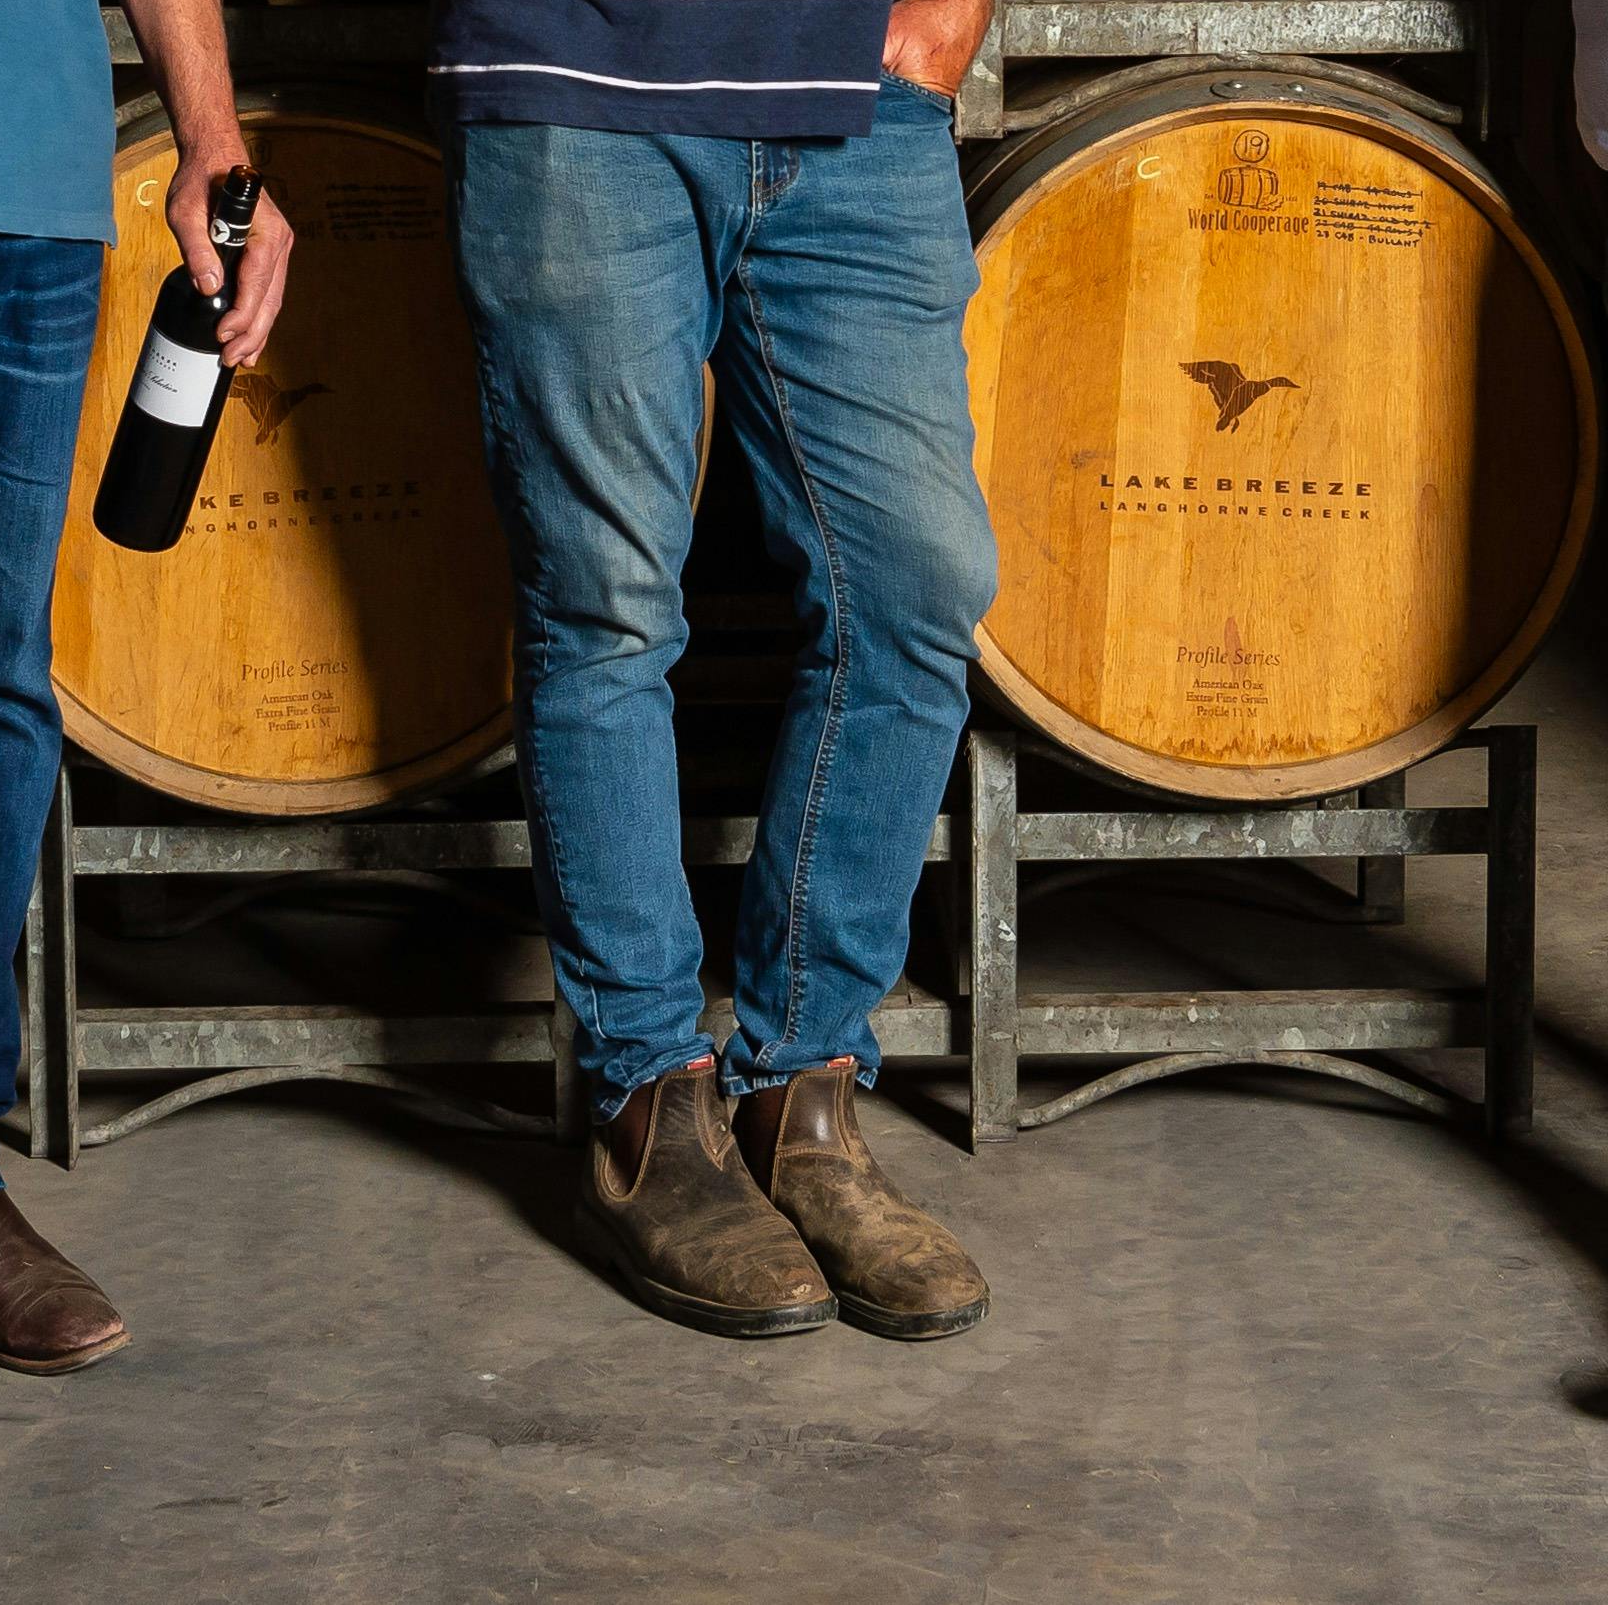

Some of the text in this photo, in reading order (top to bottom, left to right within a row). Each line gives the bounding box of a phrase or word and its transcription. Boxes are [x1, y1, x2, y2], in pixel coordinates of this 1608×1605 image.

[1244, 135, 1263, 156] 19
[1137, 156, 1161, 179] C
[136, 179, 158, 207] C
[1188, 208, 1309, 235] World Cooperage
[1335, 231, 1354, 242] CAB
[1369, 235, 1419, 248] BULLANT
[1100, 474, 1371, 496] LAKE BREEZE
[1100, 501, 1370, 520] LANGHORNE CREEK
[1176, 646, 1281, 669] Profile Series
[242, 658, 349, 683] Profile Series
[1192, 679, 1239, 690] American
[261, 690, 334, 704] American Oak
[1186, 692, 1269, 704] Extra Fine Grain
[256, 704, 340, 719] Extra Fine Grain
[1247, 707, 1257, 718] M
[268, 720, 302, 732] Profile
[319, 717, 331, 729] M
